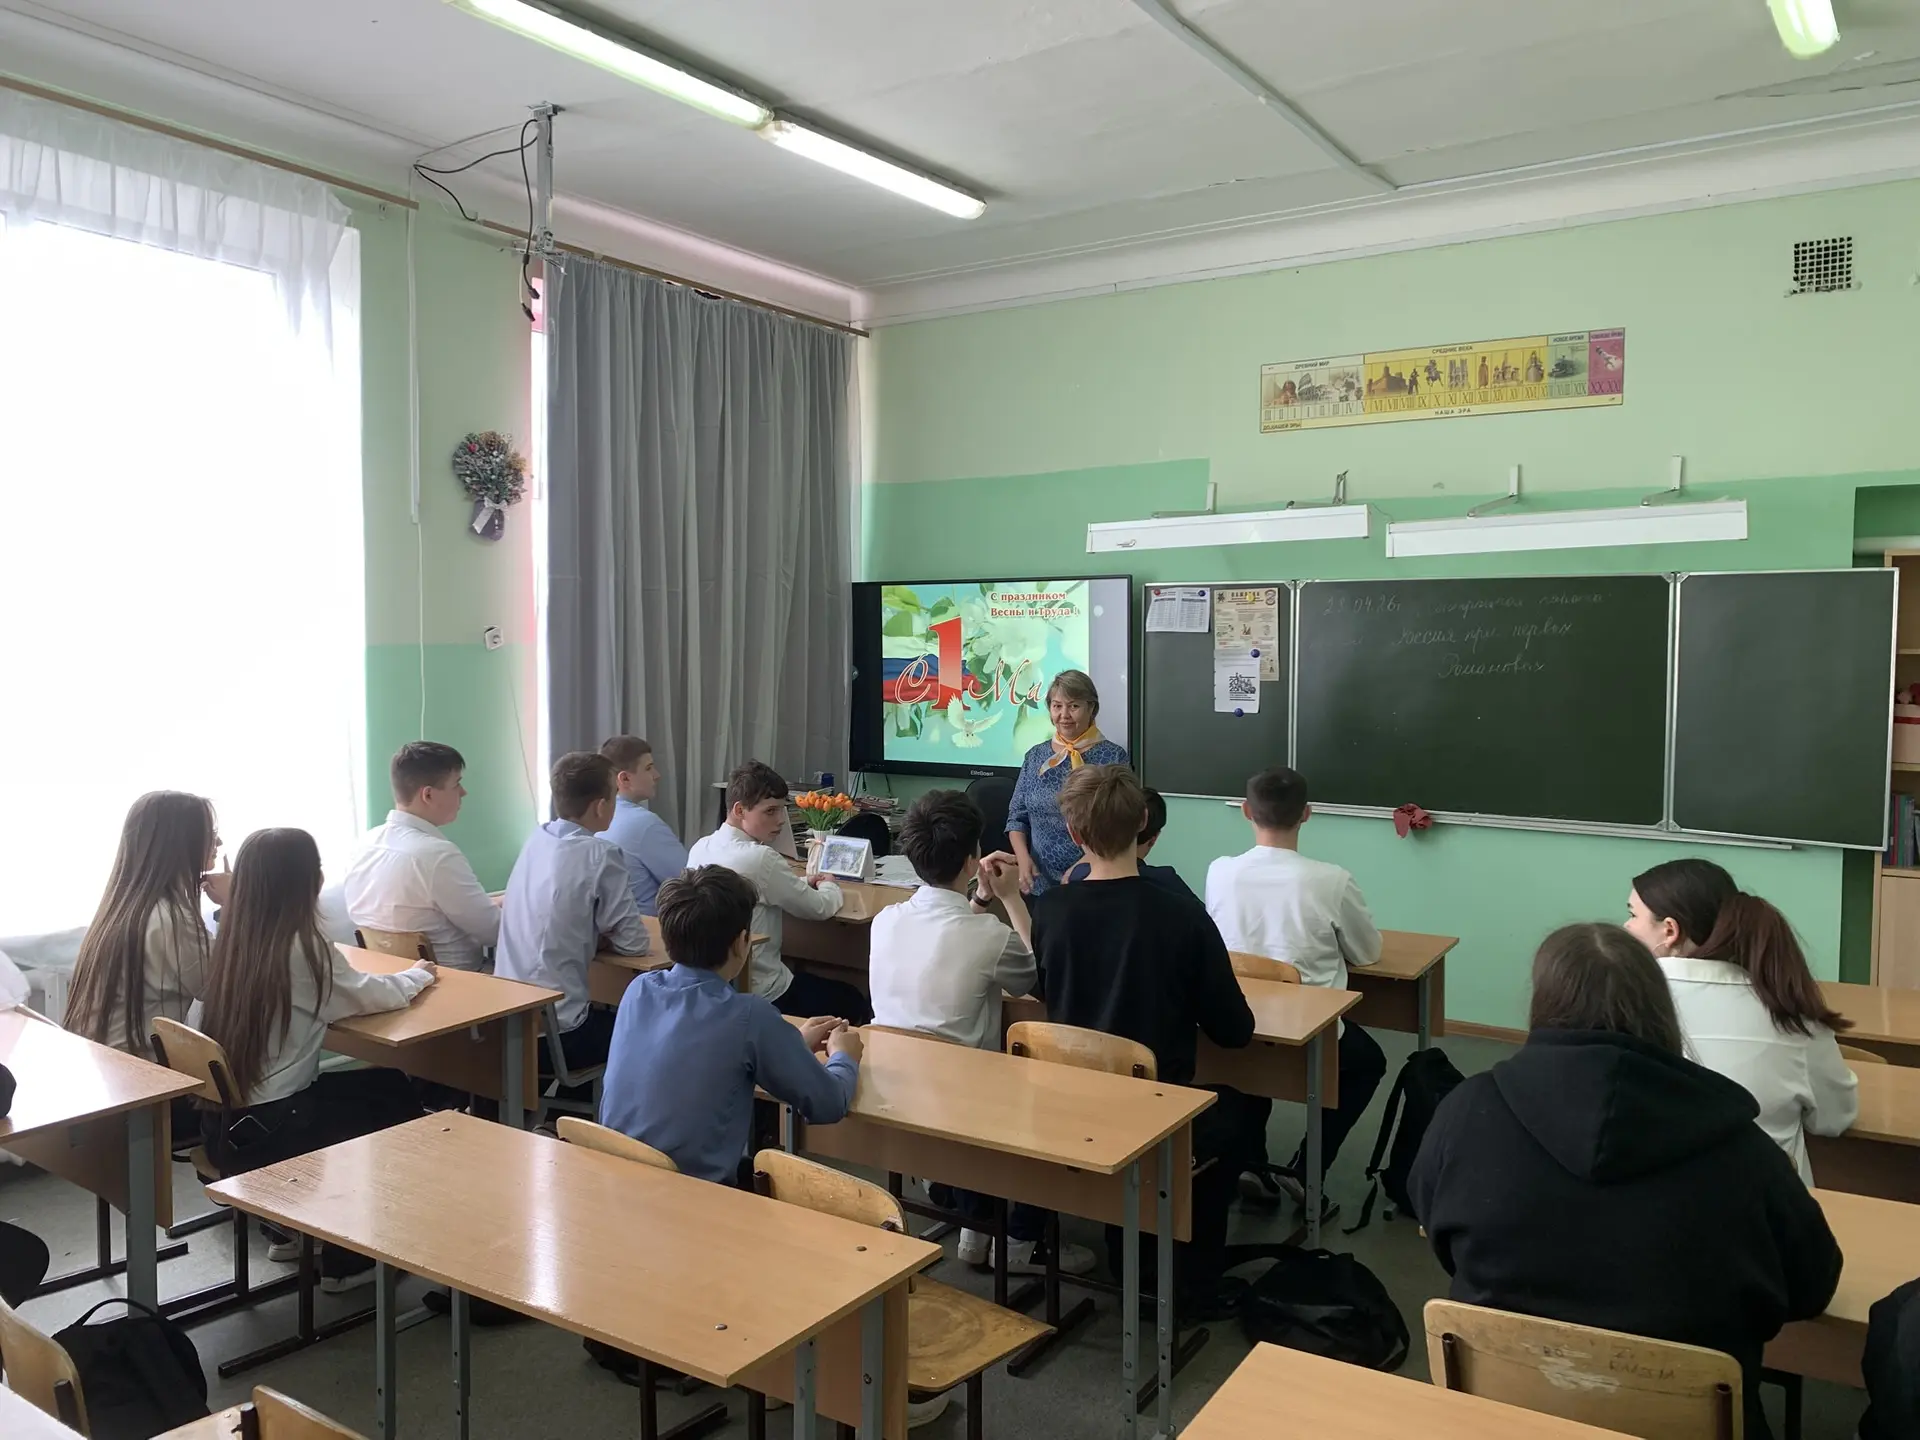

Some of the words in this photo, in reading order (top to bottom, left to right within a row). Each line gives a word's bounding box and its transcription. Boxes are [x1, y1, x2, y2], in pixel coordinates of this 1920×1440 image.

[1432, 346, 1457, 354] СРЕДНИЕ
[1374, 400, 1383, 411] VI
[990, 592, 997, 601] С
[1001, 592, 1066, 602] праздником
[991, 608, 1024, 616] Весны
[928, 616, 971, 710] 1
[968, 658, 1046, 706] Ма
